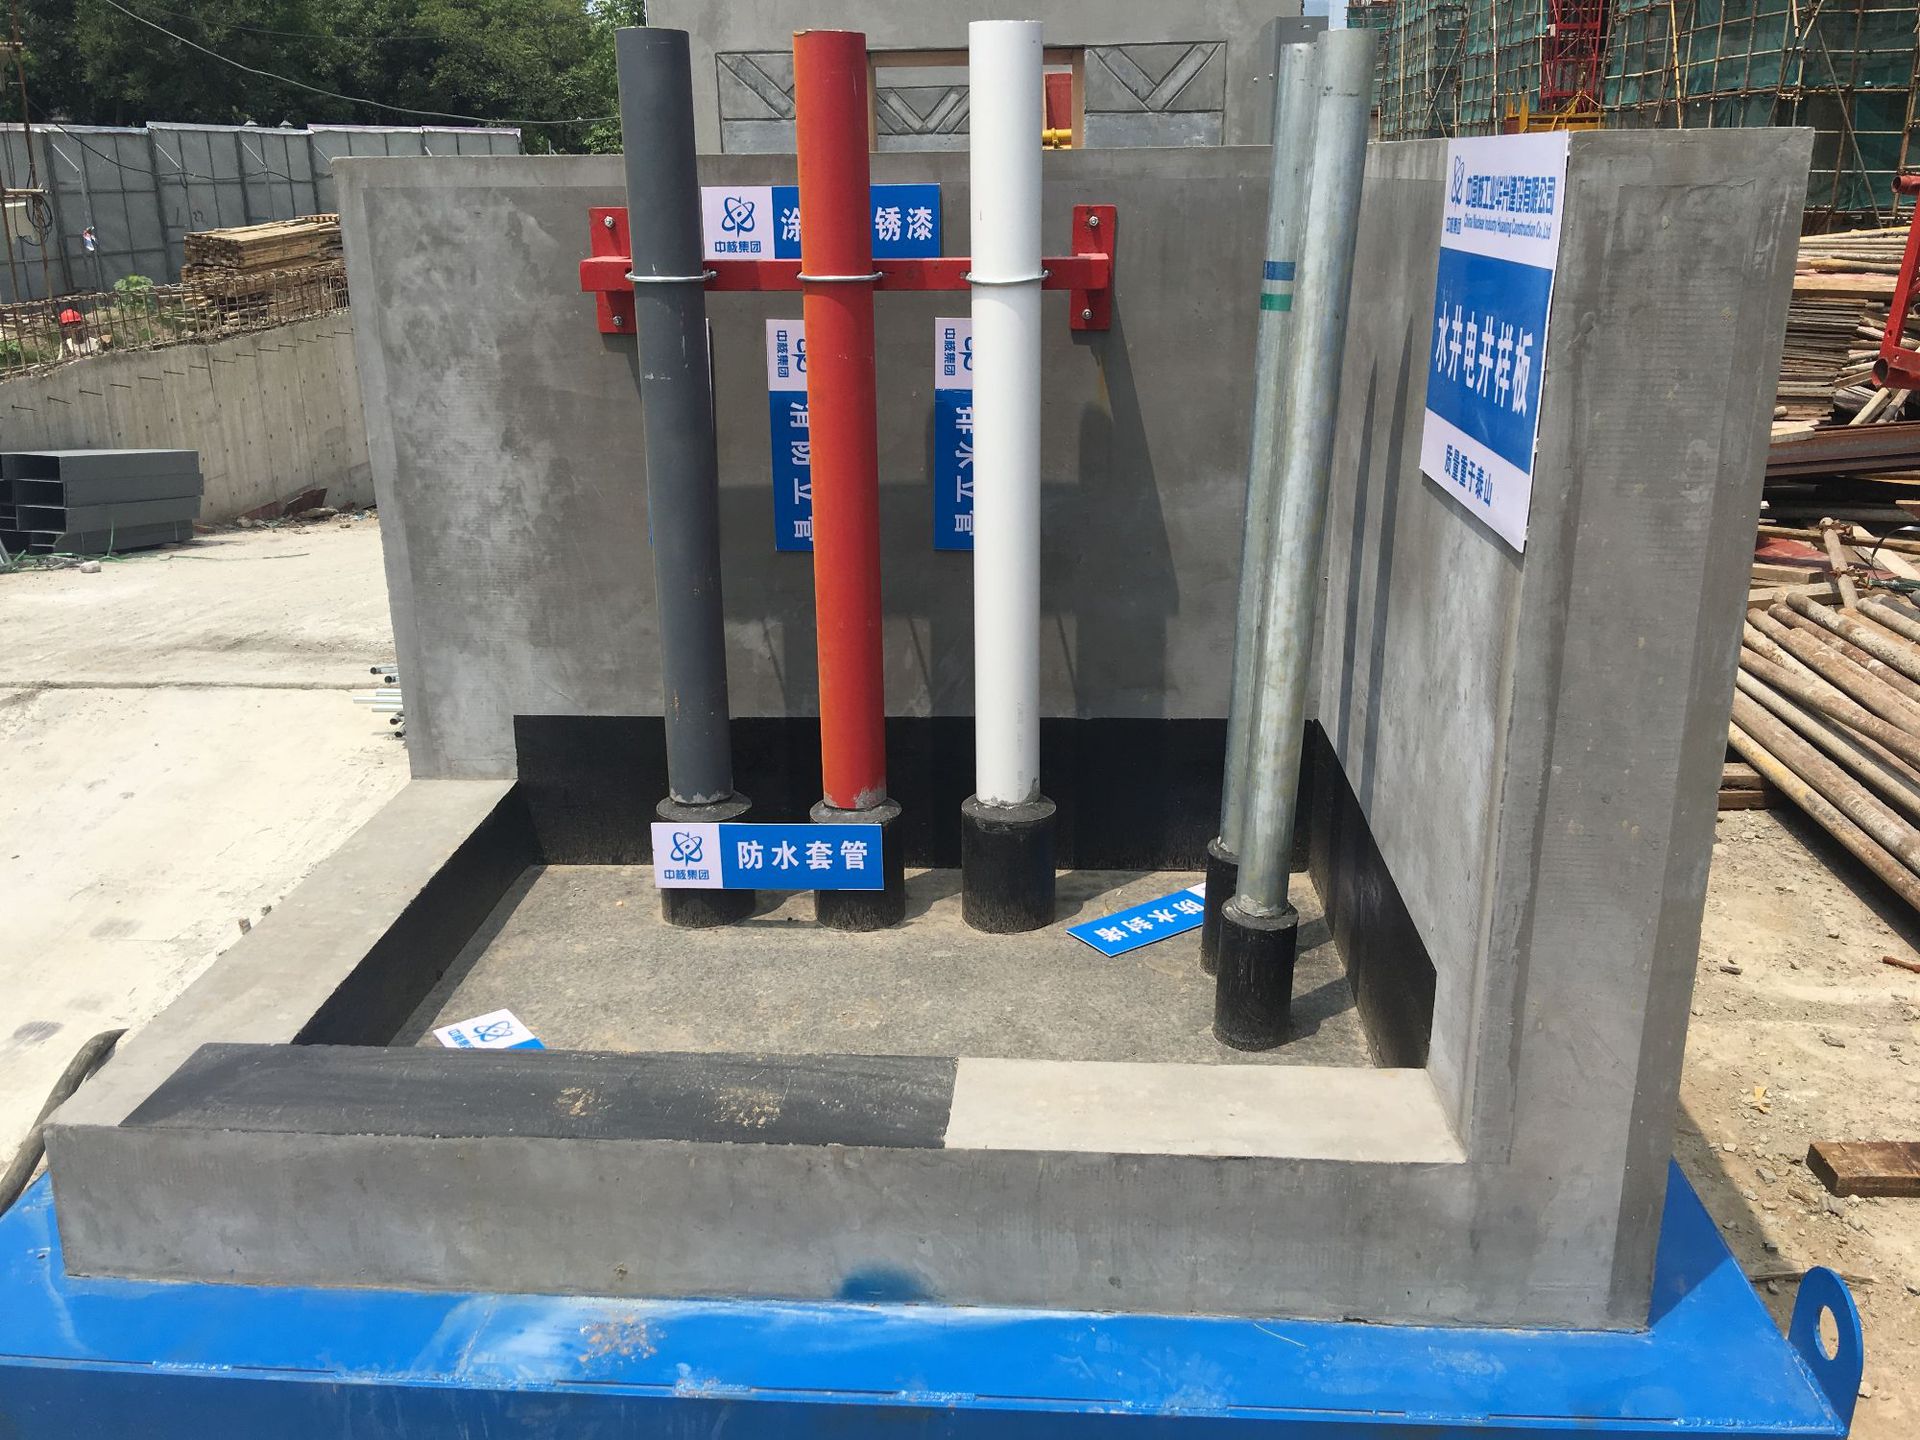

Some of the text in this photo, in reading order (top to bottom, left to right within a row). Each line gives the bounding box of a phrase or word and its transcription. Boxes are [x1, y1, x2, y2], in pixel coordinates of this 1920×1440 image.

[781, 206, 933, 242] 涂锈漆
[715, 241, 762, 253] 中核集团
[777, 330, 789, 378] 中核集团
[944, 328, 956, 376] 中核集团
[1435, 301, 1533, 417] 水井电井样板
[1444, 444, 1493, 508] 质量重于泰山
[664, 869, 710, 880] 中核集团
[737, 840, 868, 870] 防水套管
[1093, 898, 1205, 942] 防水封堵
